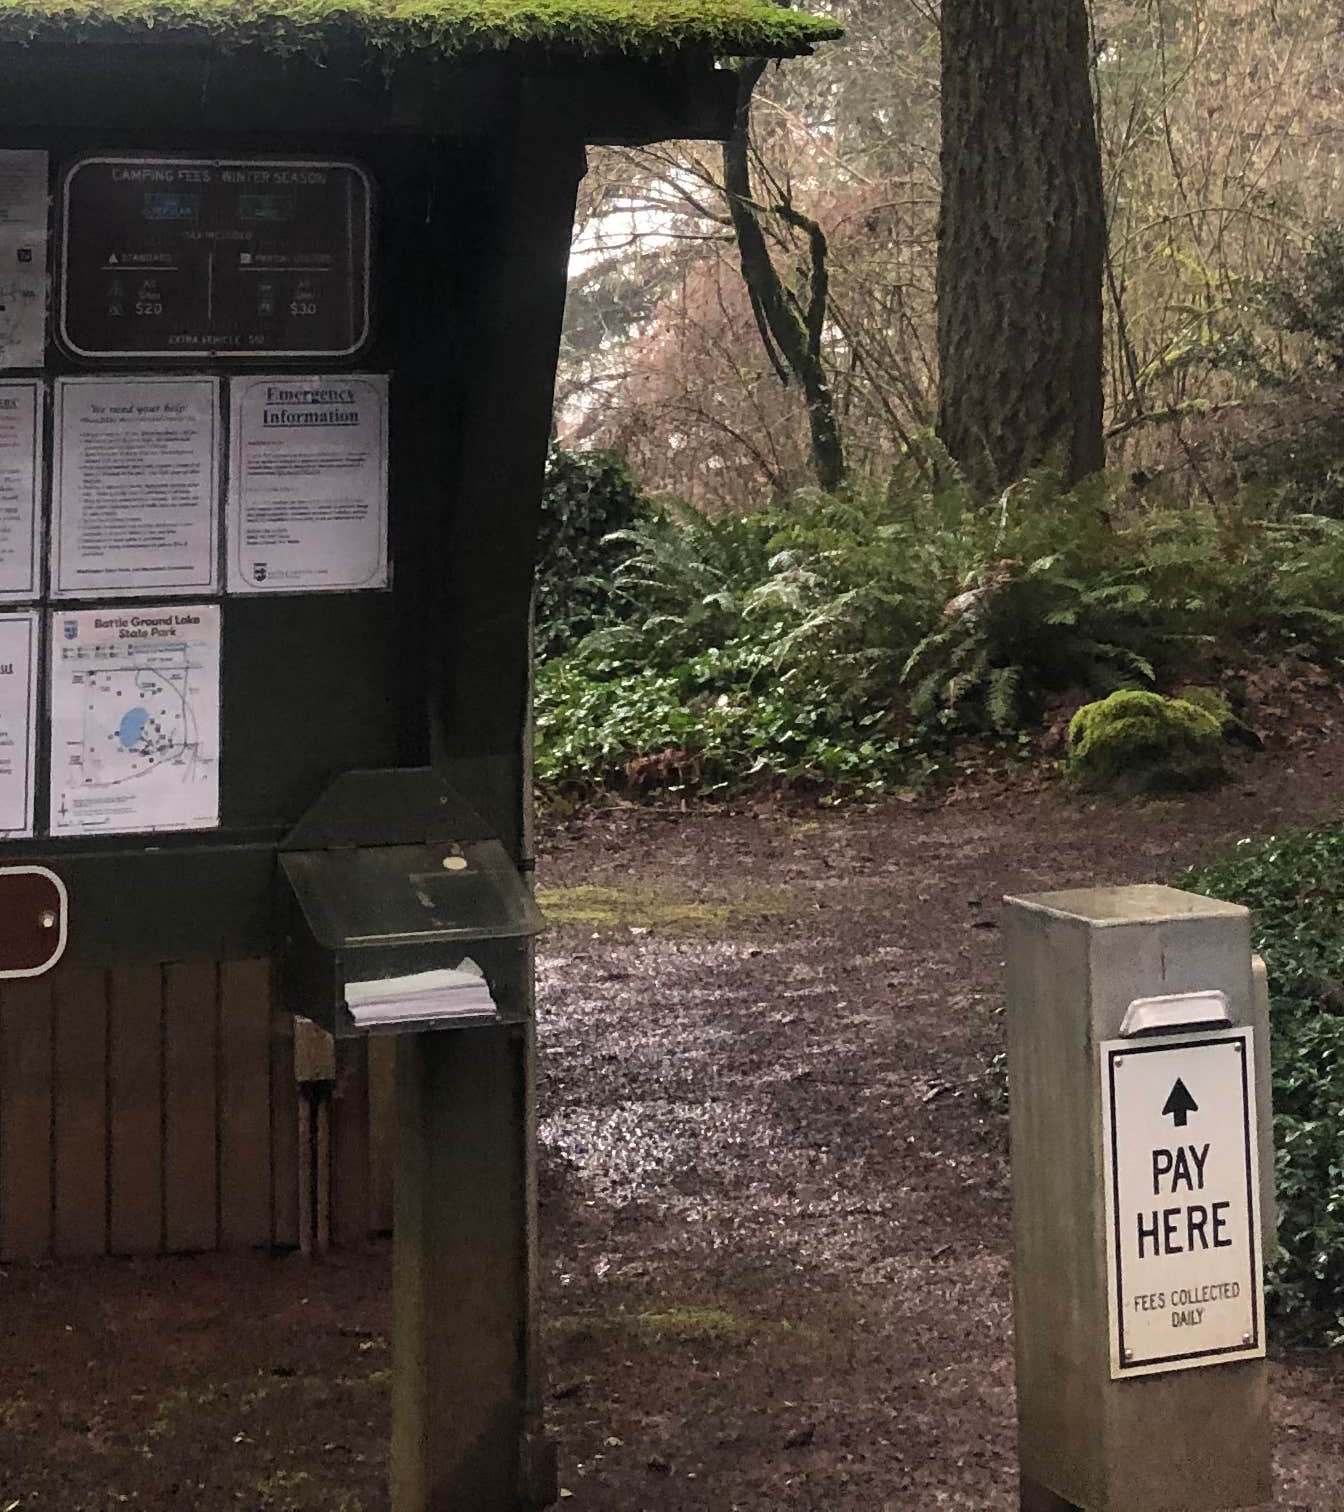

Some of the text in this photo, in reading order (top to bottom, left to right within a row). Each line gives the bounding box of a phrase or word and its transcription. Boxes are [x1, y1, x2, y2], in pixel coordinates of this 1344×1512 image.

[266, 387, 355, 405] Emergency
[263, 409, 359, 425] Information
[94, 615, 200, 629] Battle Ground Lake
[119, 627, 177, 639] State Park
[1152, 1143, 1210, 1195] PAY
[1137, 1201, 1232, 1259] HERE
[1134, 1282, 1240, 1312] FEES COLLECTED
[1171, 1308, 1205, 1328] DAILY
